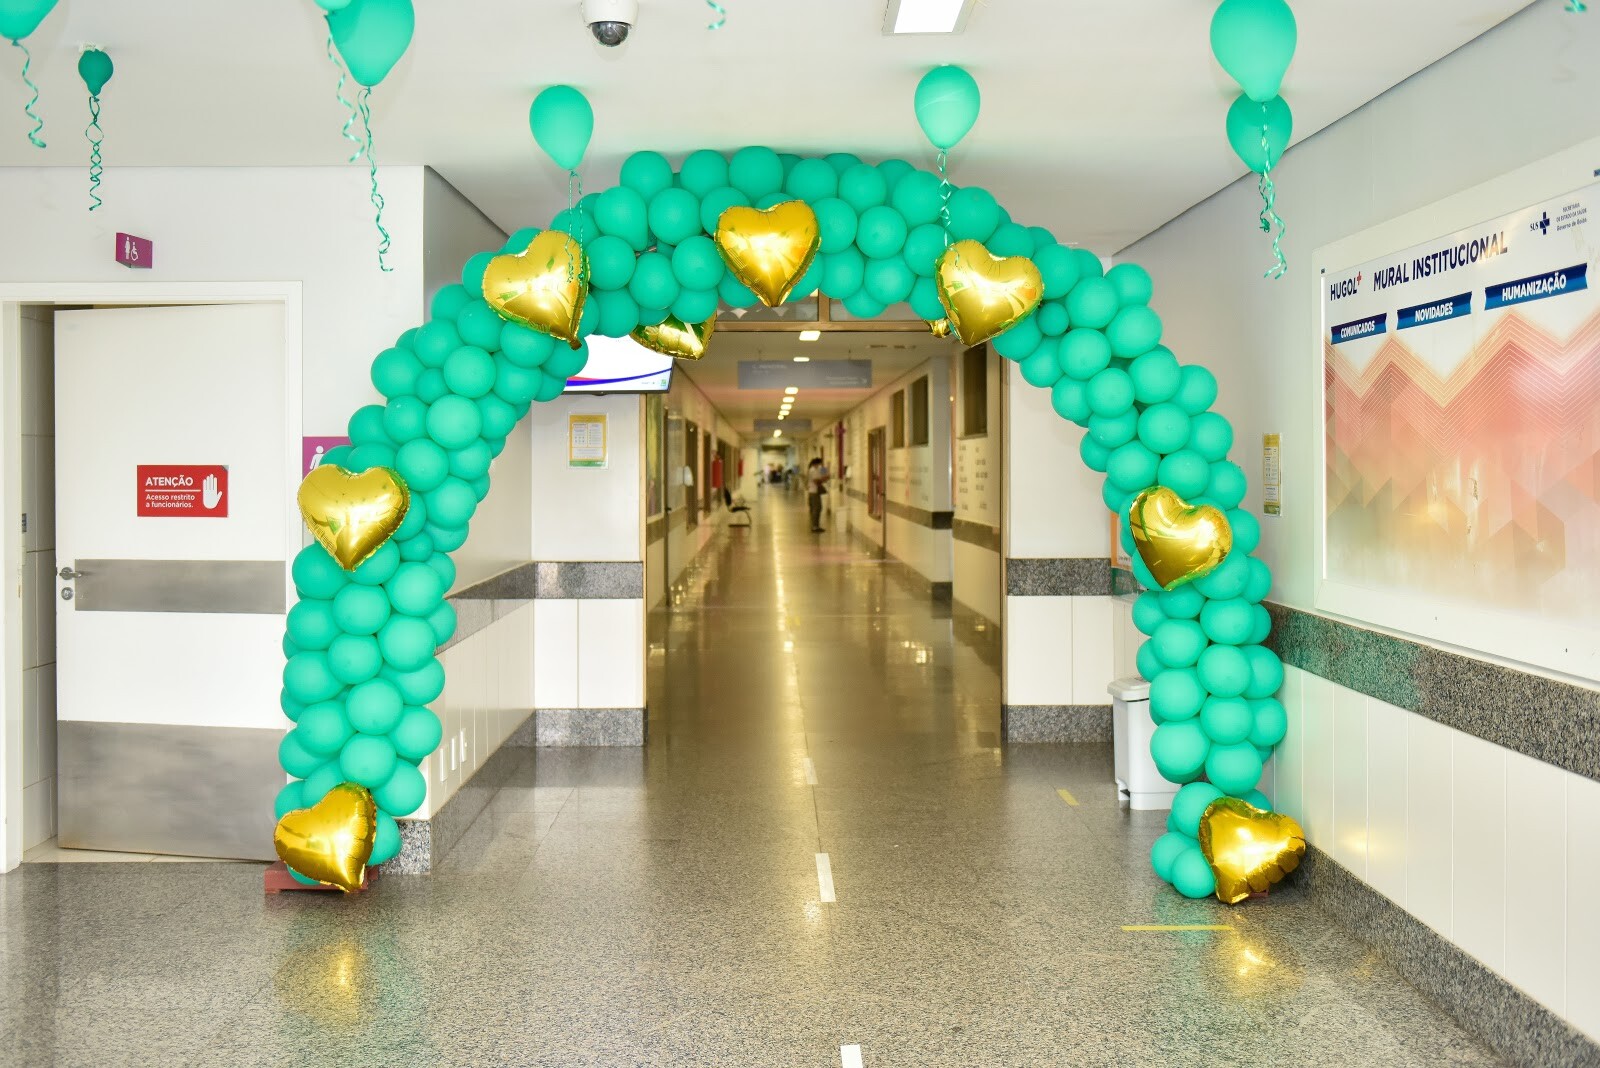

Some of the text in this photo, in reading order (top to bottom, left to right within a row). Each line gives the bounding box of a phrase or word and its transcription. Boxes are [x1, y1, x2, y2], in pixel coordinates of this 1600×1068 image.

[1530, 222, 1538, 231] SUS
[1373, 231, 1508, 292] MURAL INSTITUCIONAL
[1330, 277, 1358, 301] HUGOL
[1501, 273, 1567, 302] HUMANIZAÇÃO
[1414, 302, 1454, 323] NOVIDADES
[1340, 320, 1376, 339] COMUNICADOS
[145, 474, 194, 488] ATENÇÃO
